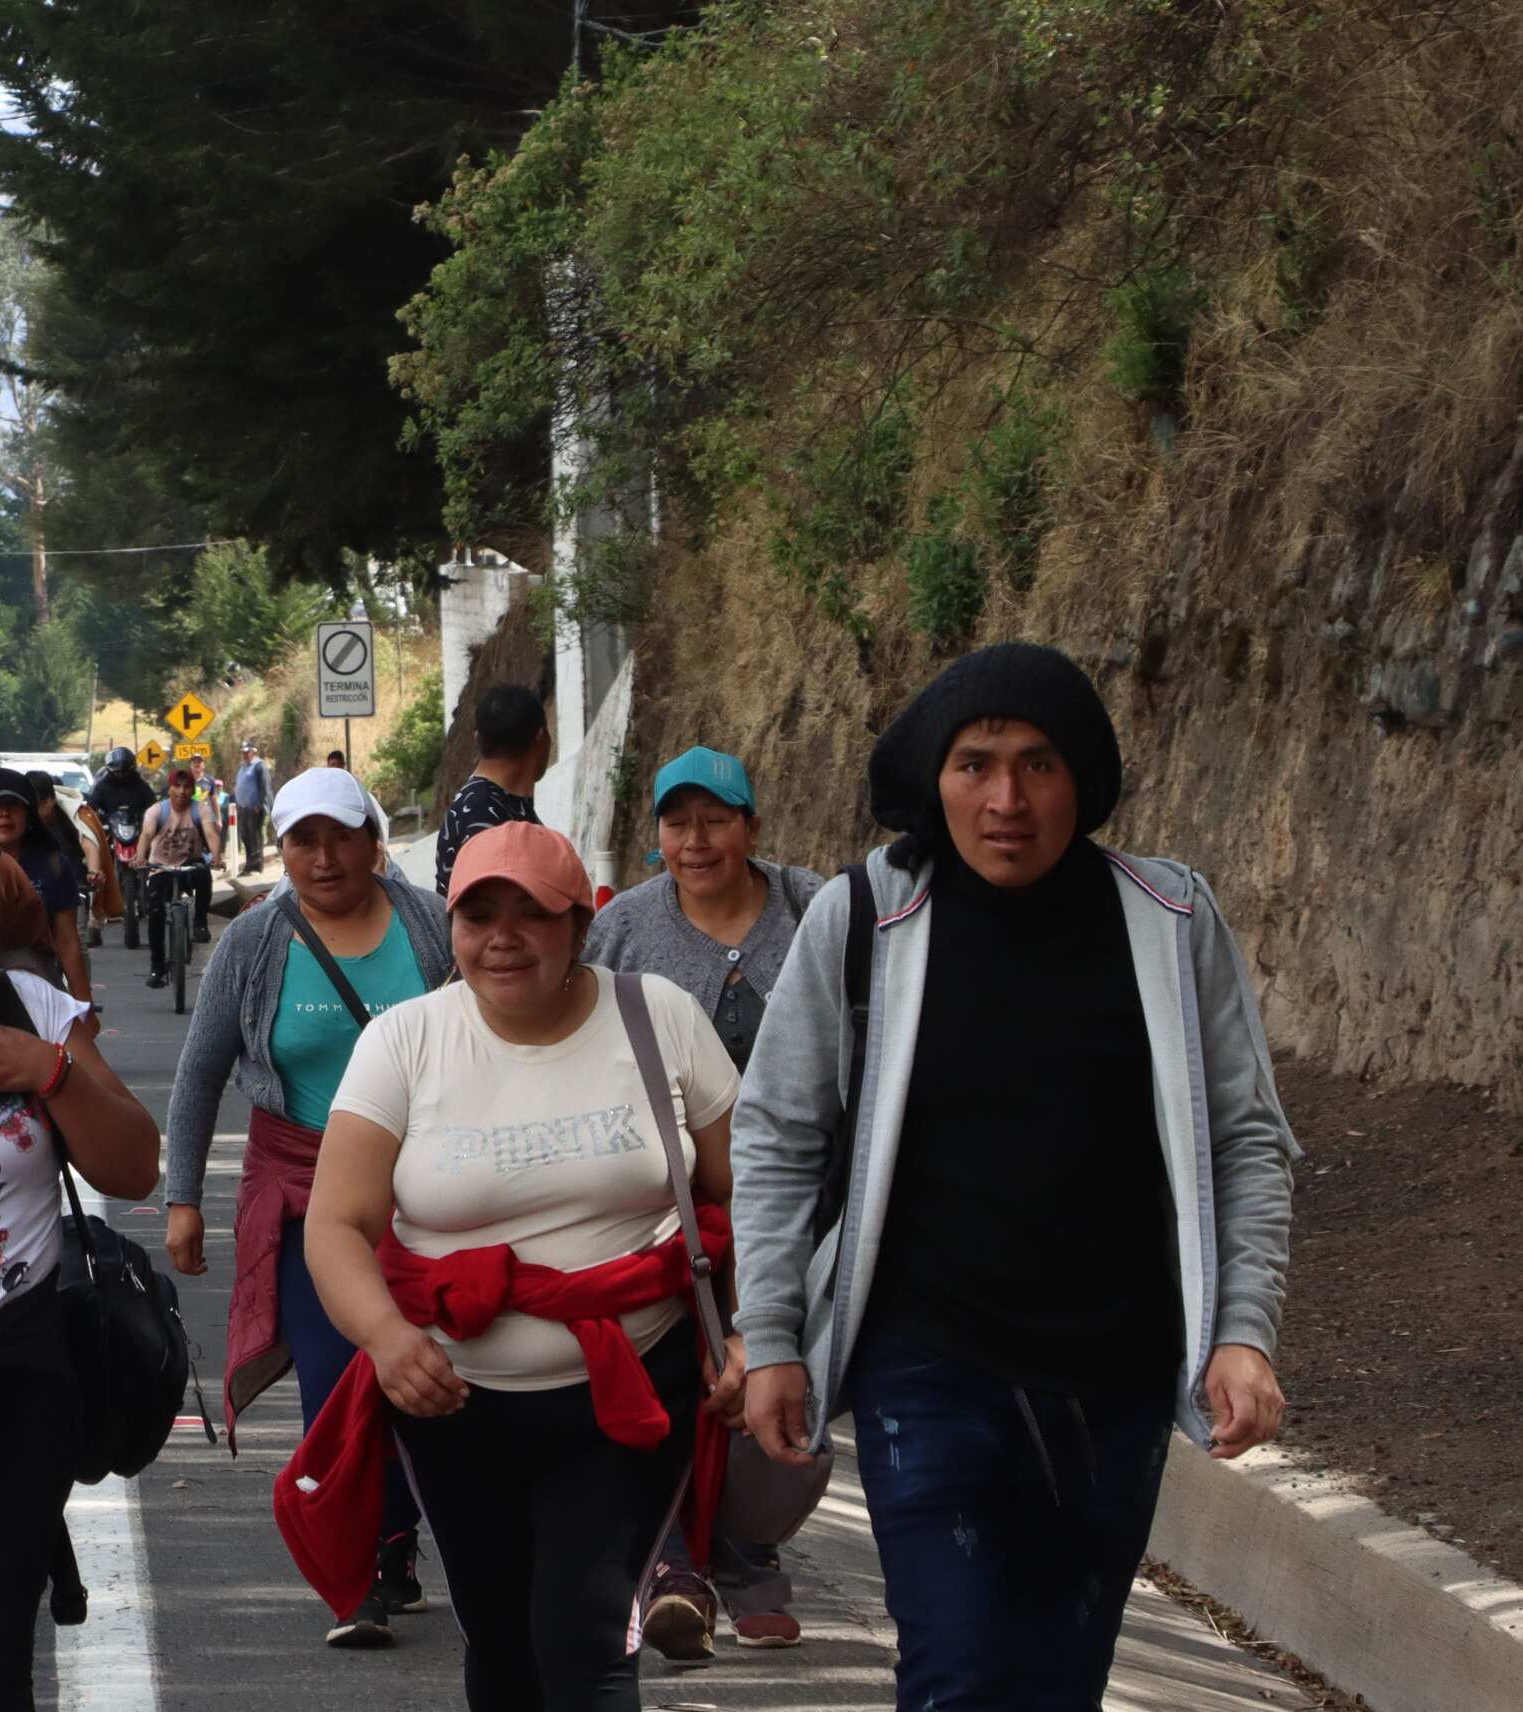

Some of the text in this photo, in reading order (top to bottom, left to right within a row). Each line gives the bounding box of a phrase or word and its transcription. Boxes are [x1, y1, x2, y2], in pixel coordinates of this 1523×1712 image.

[324, 681, 370, 692] TERMINA
[178, 746, 208, 757] 150m
[295, 1003, 343, 1012] TOMM
[437, 1103, 646, 1175] PINK
